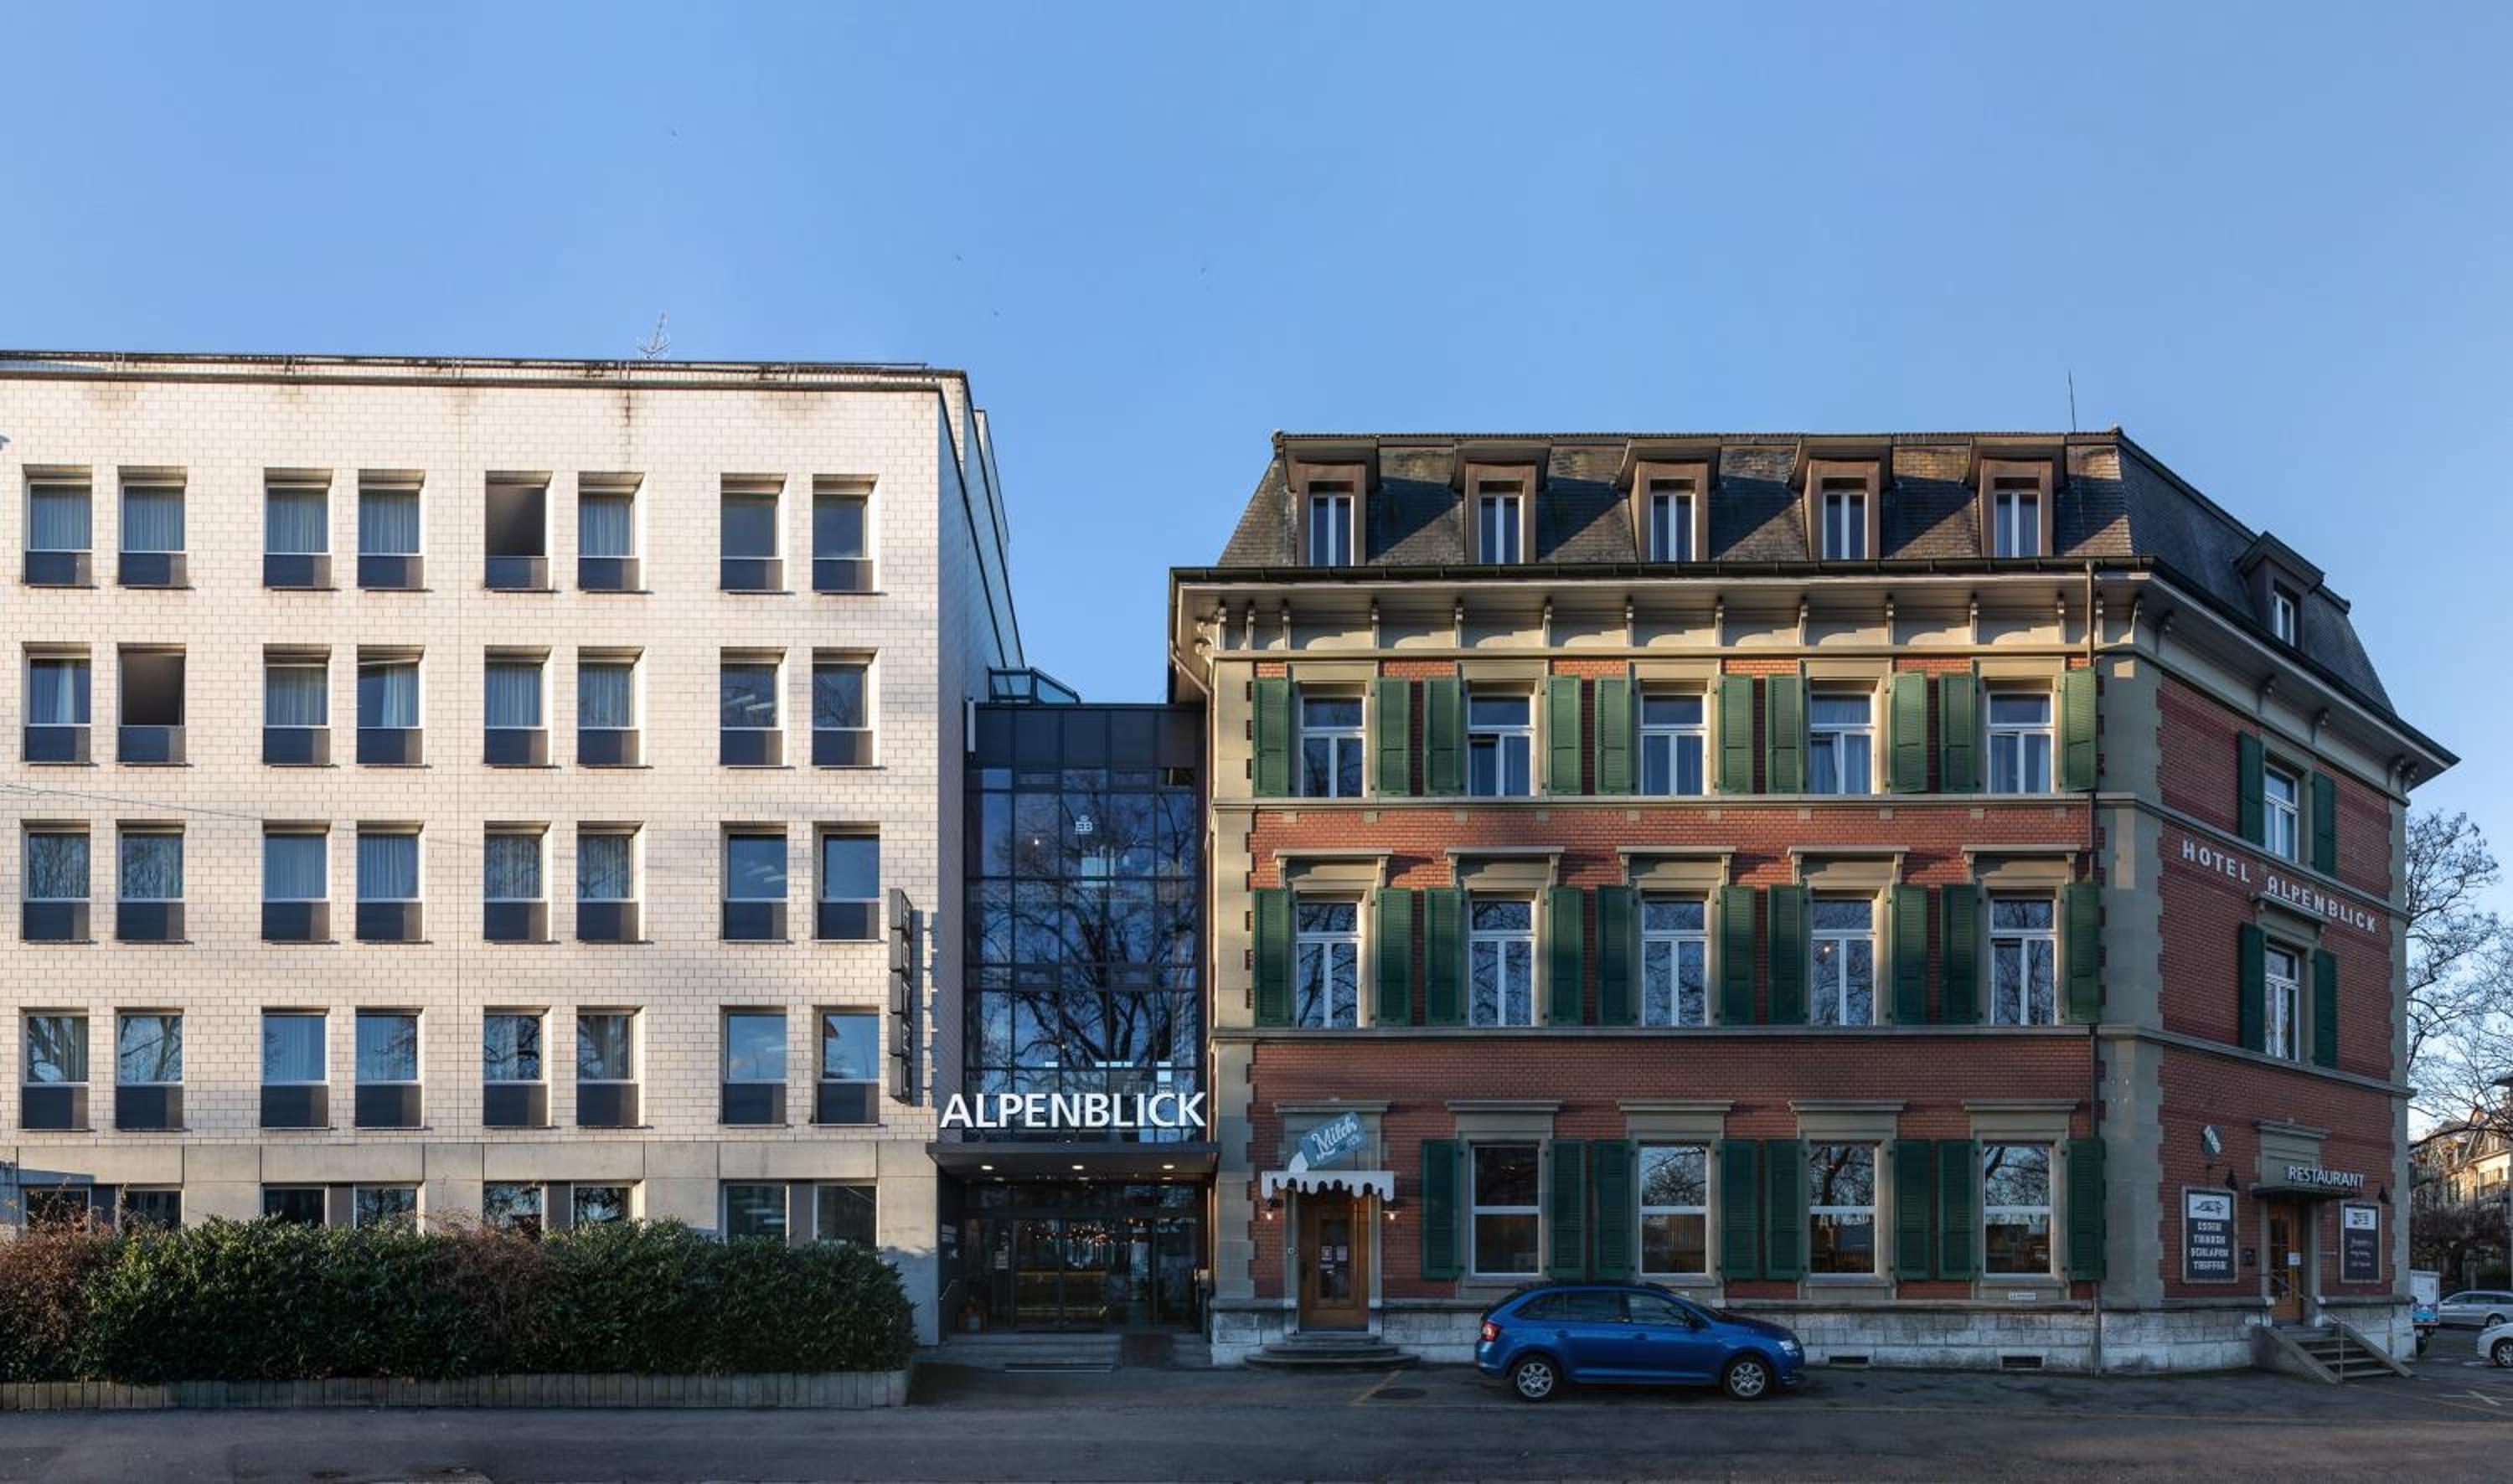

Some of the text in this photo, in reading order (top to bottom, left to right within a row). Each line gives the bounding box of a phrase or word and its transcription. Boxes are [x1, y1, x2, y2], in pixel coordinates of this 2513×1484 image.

[2182, 840, 2376, 933] HOTEL ALPENBLICK
[939, 1091, 1206, 1129] ALPENBLICK
[1311, 1115, 1358, 1161] Milch
[2288, 1165, 2366, 1188] RESTAURANT
